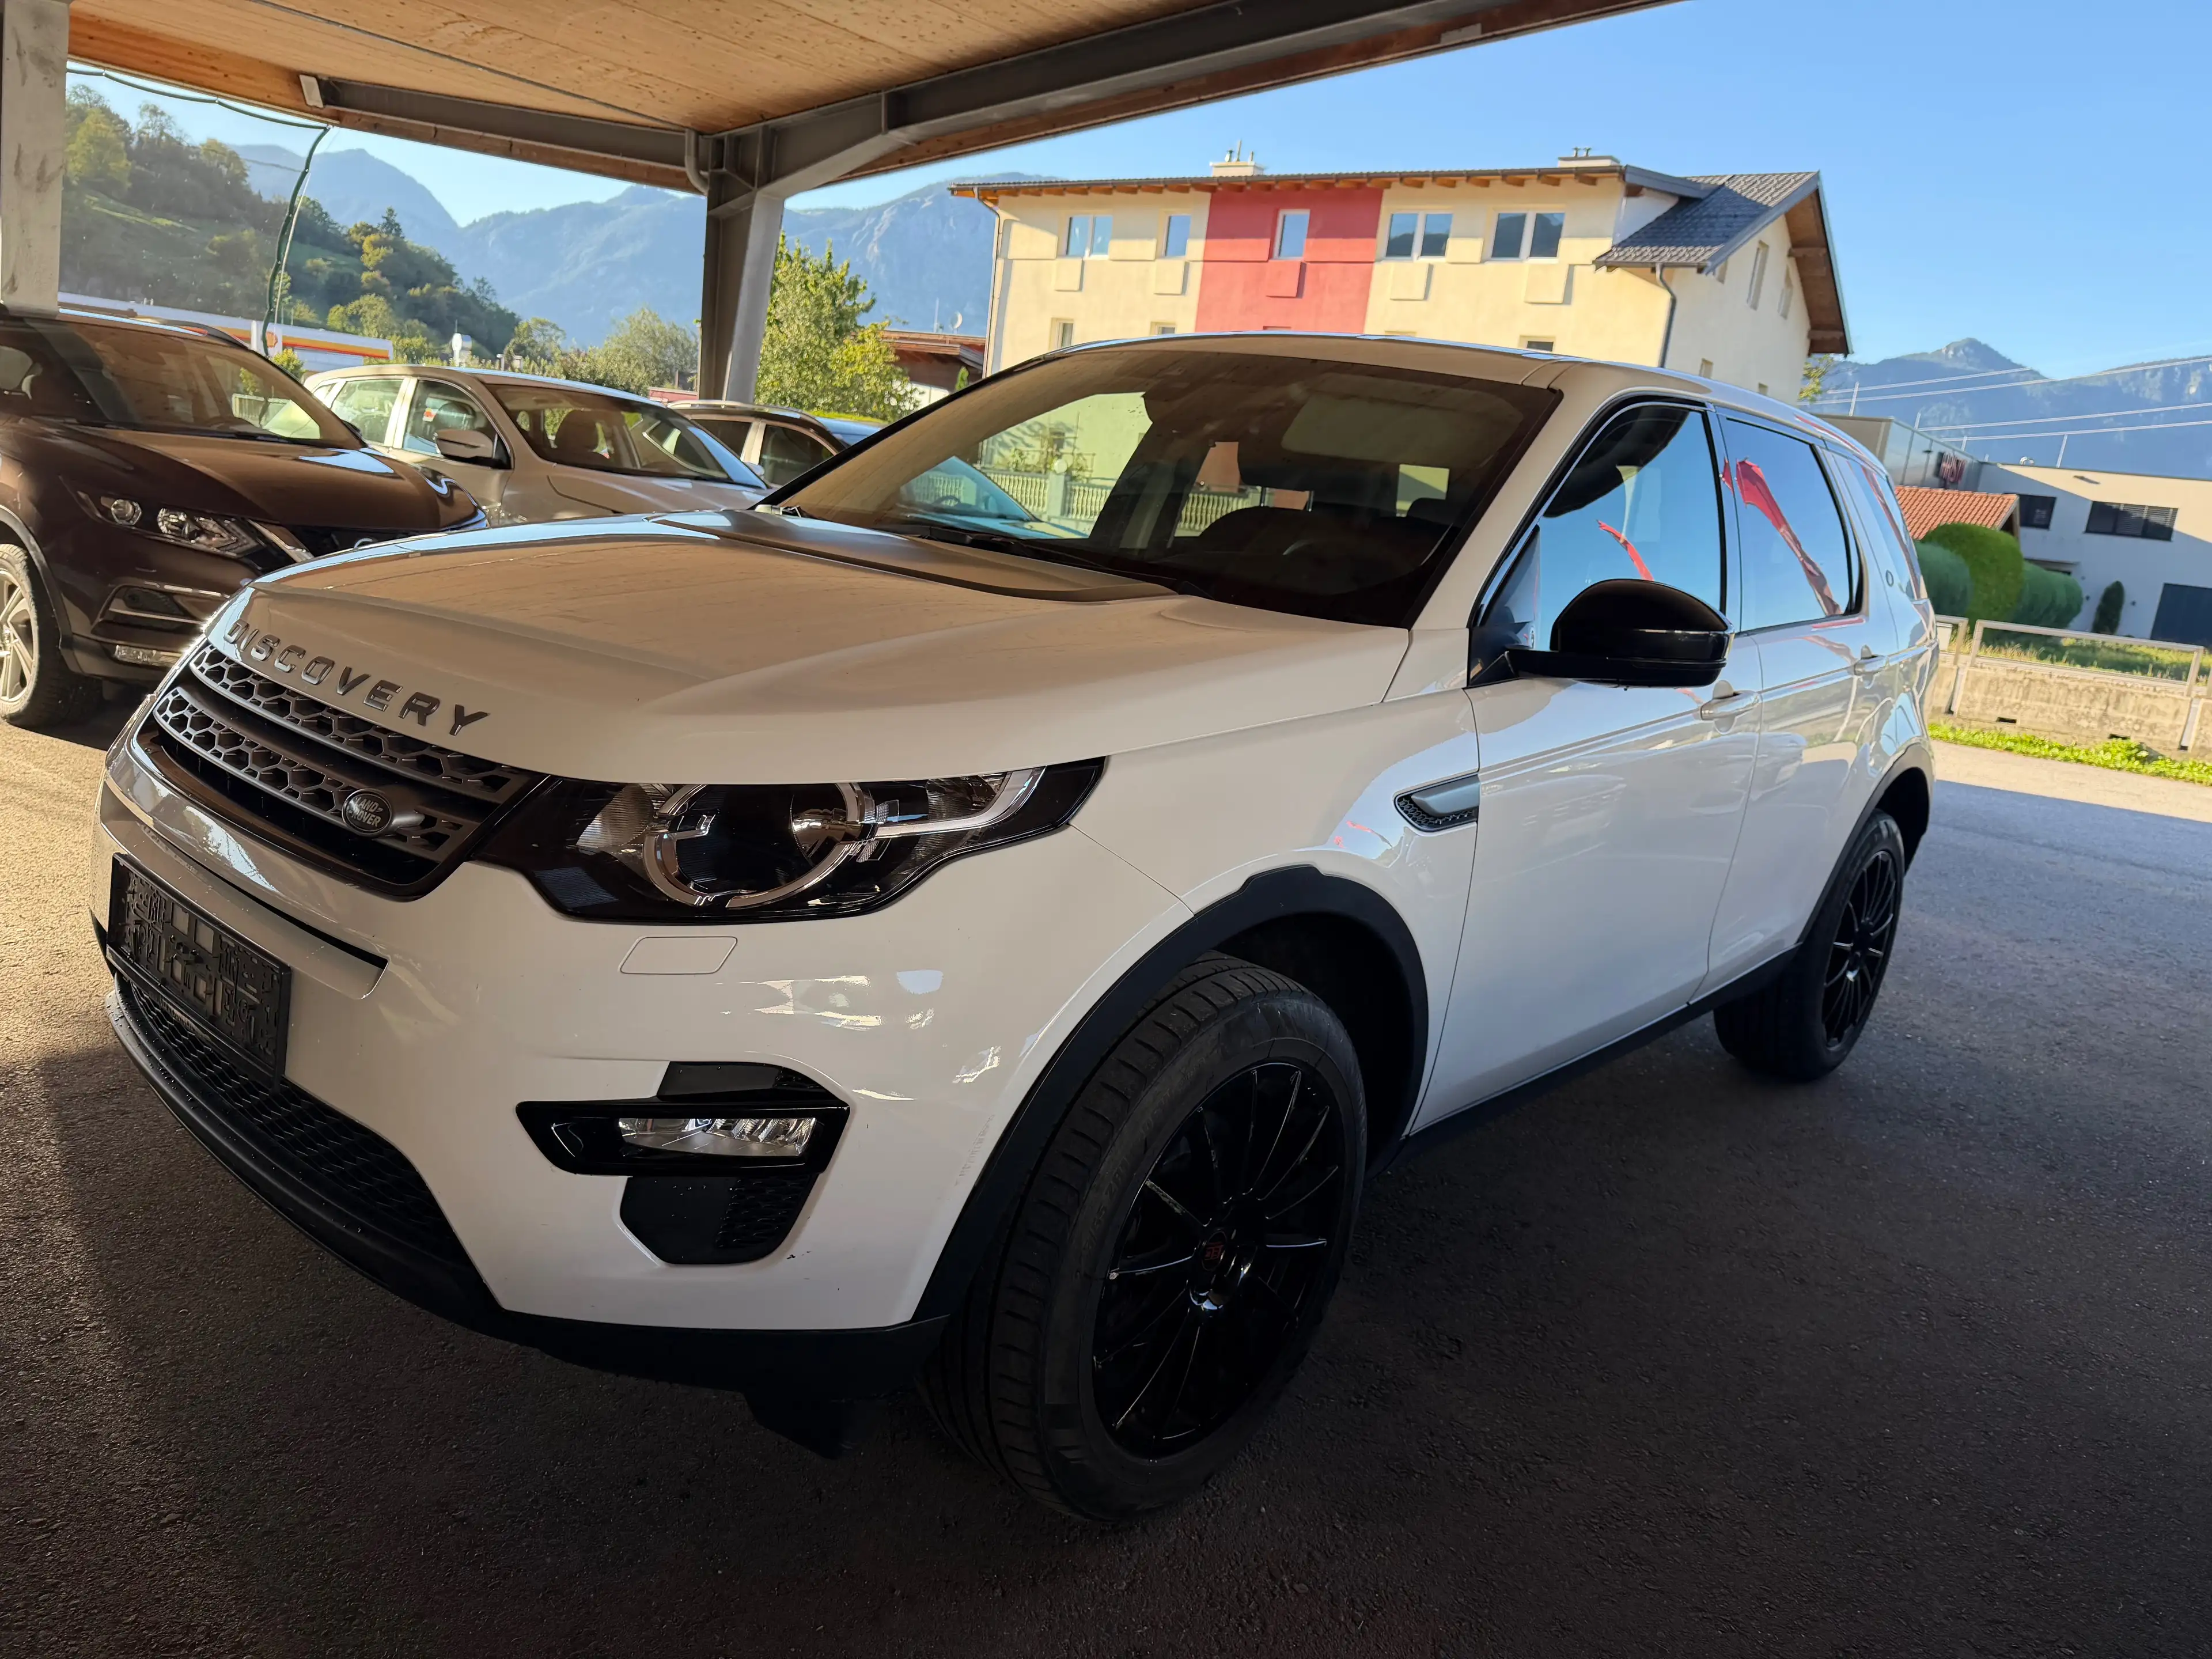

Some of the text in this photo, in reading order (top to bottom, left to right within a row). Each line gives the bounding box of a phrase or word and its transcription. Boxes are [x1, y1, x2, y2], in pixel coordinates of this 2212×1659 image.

[223, 618, 490, 736] DISCOVERY
[354, 797, 380, 813] LAND
[351, 807, 381, 827] ROVER
